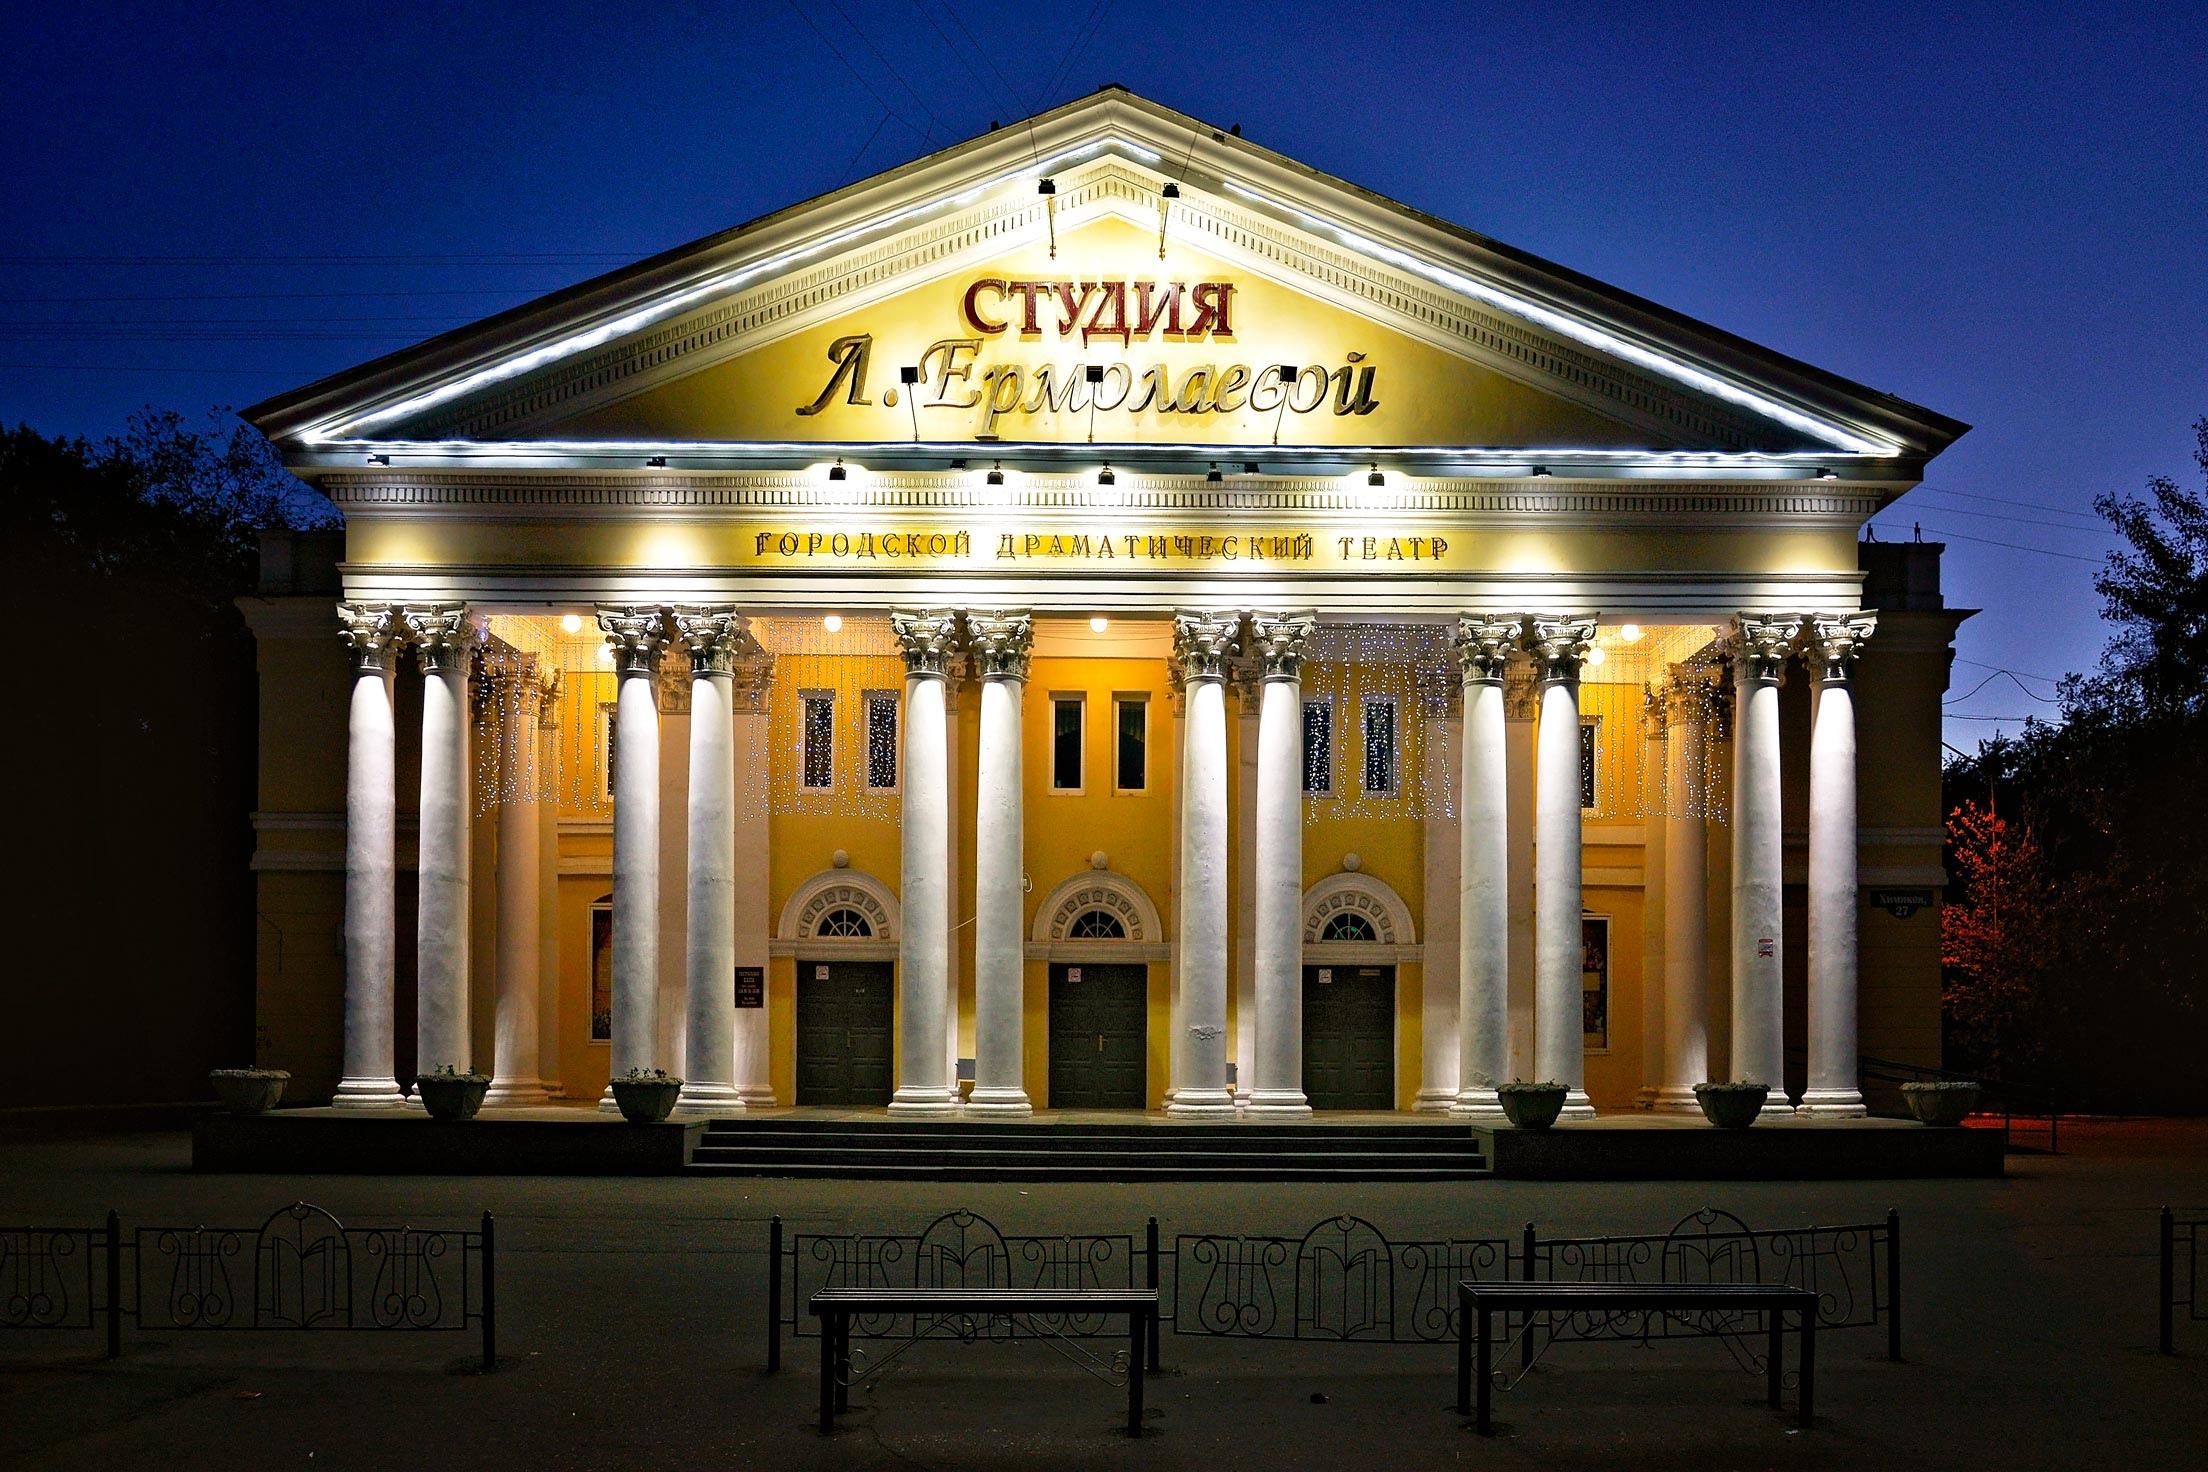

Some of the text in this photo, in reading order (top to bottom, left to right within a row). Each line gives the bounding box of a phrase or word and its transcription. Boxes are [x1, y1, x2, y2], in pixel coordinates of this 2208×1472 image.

[964, 277, 1235, 349] СТУДИЯ
[795, 333, 1381, 440] Л. Ермолаевой
[754, 531, 1449, 561] ГОРОДСКОЙ ДРАМАТИЧЕСКИЙ ТЕАТР
[1895, 905, 1908, 916] 27
